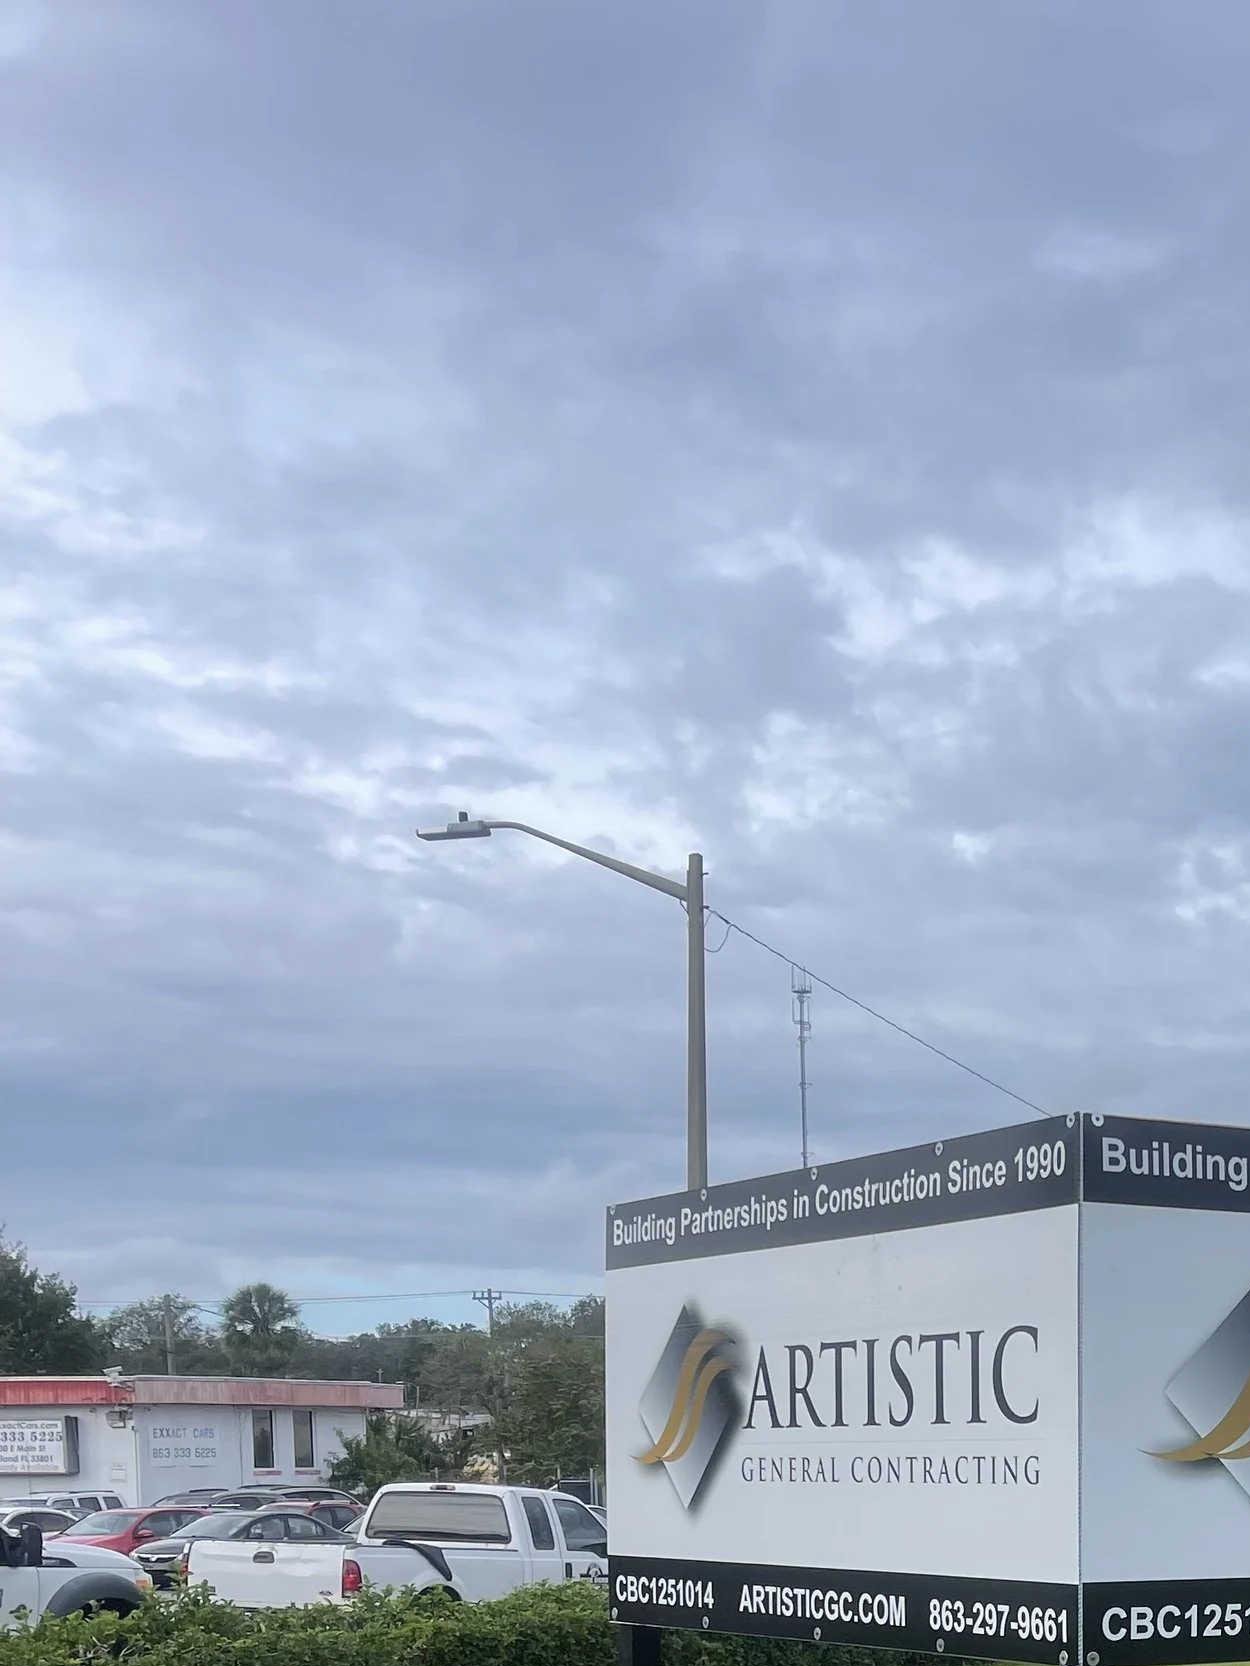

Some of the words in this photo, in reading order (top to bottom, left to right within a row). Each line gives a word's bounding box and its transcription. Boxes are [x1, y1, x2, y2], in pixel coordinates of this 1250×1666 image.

[1102, 1137, 1247, 1191] Building
[613, 1210, 675, 1245] Building
[681, 1197, 787, 1235] Partnerships
[794, 1190, 809, 1218] in
[814, 1168, 940, 1215] Construction
[948, 1159, 1006, 1193] Since
[1015, 1141, 1065, 1181] 1990
[742, 1326, 1038, 1431] ARTISTIC
[30, 1431, 63, 1442] 5225
[153, 1428, 187, 1439] EXXACT
[193, 1428, 215, 1439] CARS
[31, 1455, 53, 1463] 33801
[153, 1448, 171, 1459] 863
[174, 1448, 191, 1459] 333
[195, 1448, 217, 1459] 5225
[742, 1457, 839, 1482] GENERAL
[852, 1456, 1039, 1484] CONTRACTING
[616, 1575, 714, 1608] CBC1251014
[739, 1585, 905, 1626] ARTISTICGC.COM
[930, 1599, 1067, 1643] 863-297-9661
